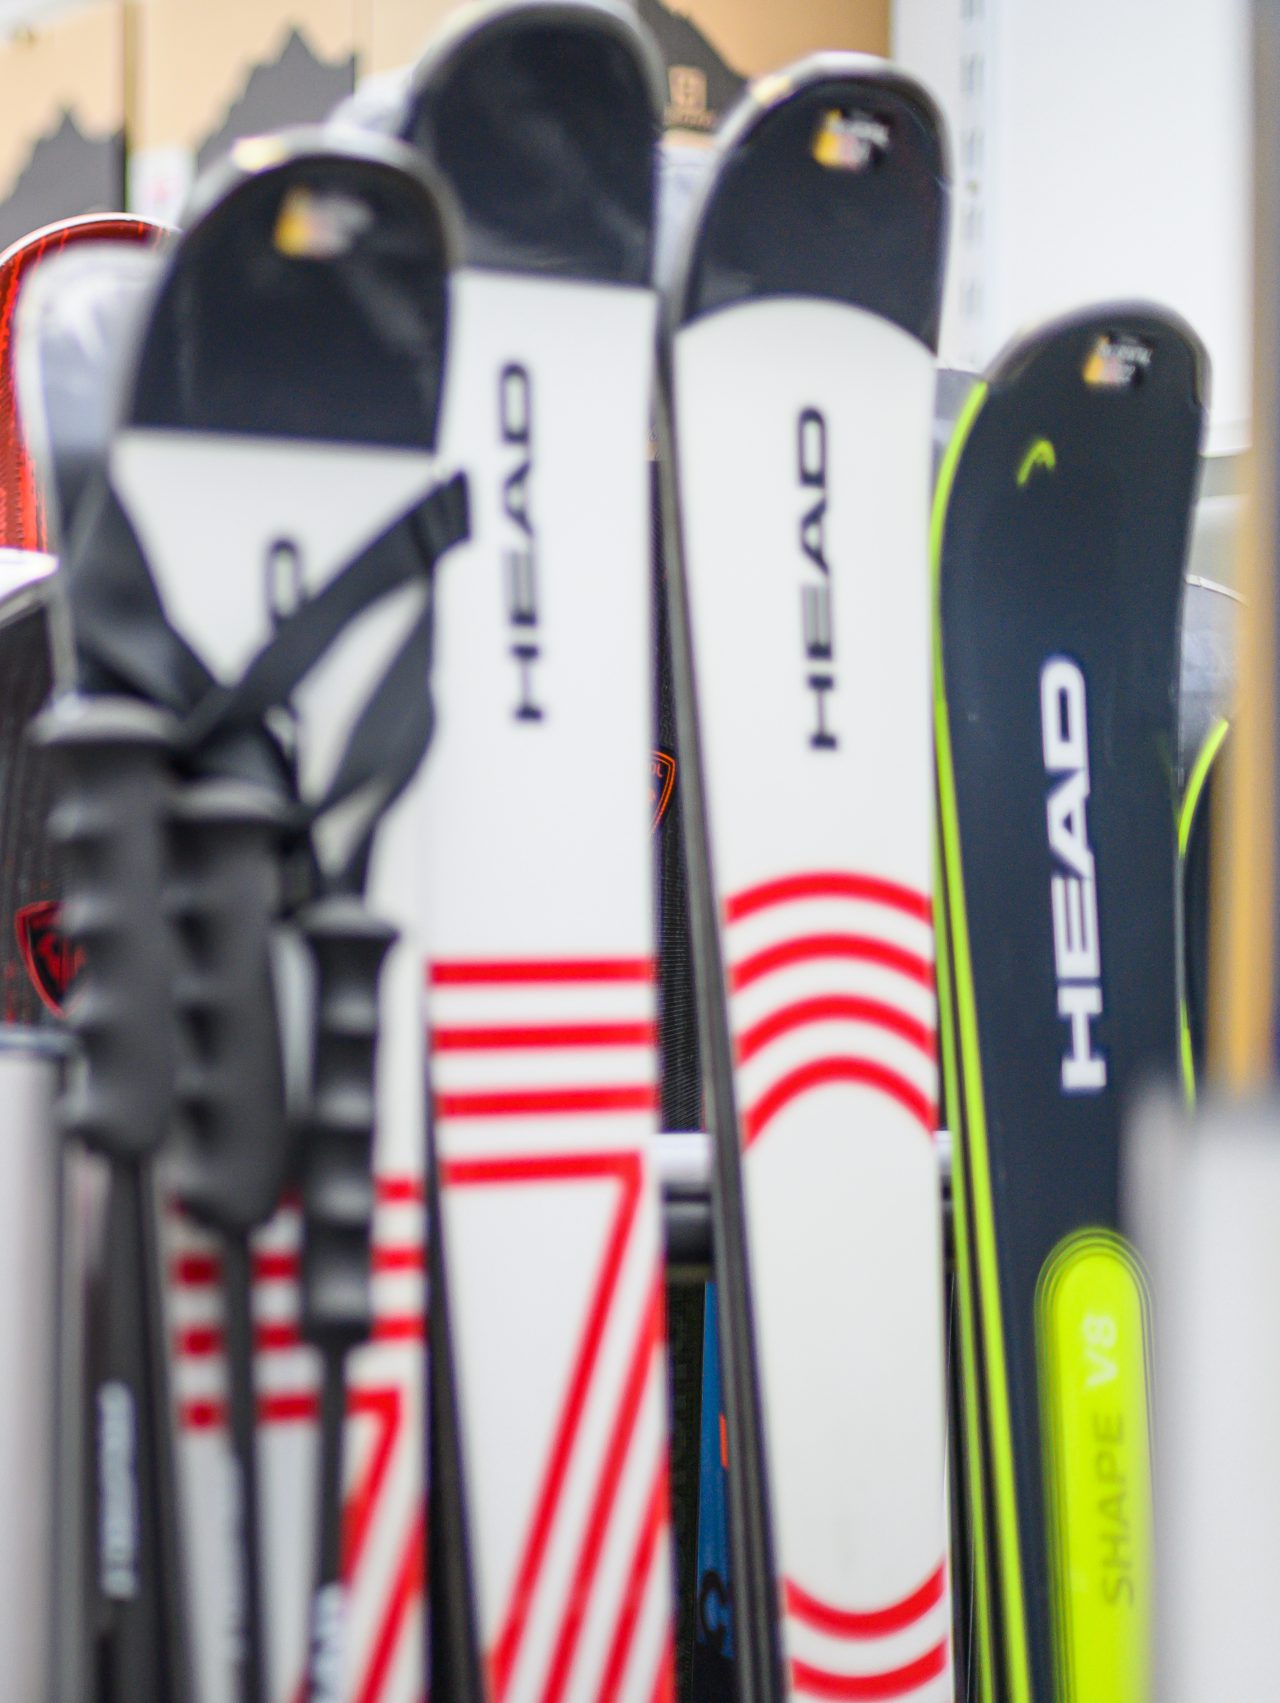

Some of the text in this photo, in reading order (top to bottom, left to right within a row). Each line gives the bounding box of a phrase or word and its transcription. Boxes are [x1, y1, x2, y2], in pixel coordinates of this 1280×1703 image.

[498, 361, 545, 722] HEAD
[797, 406, 838, 752] HEAD
[1039, 655, 1108, 1092] HEAD
[1081, 1314, 1136, 1606] SHAPE V8
